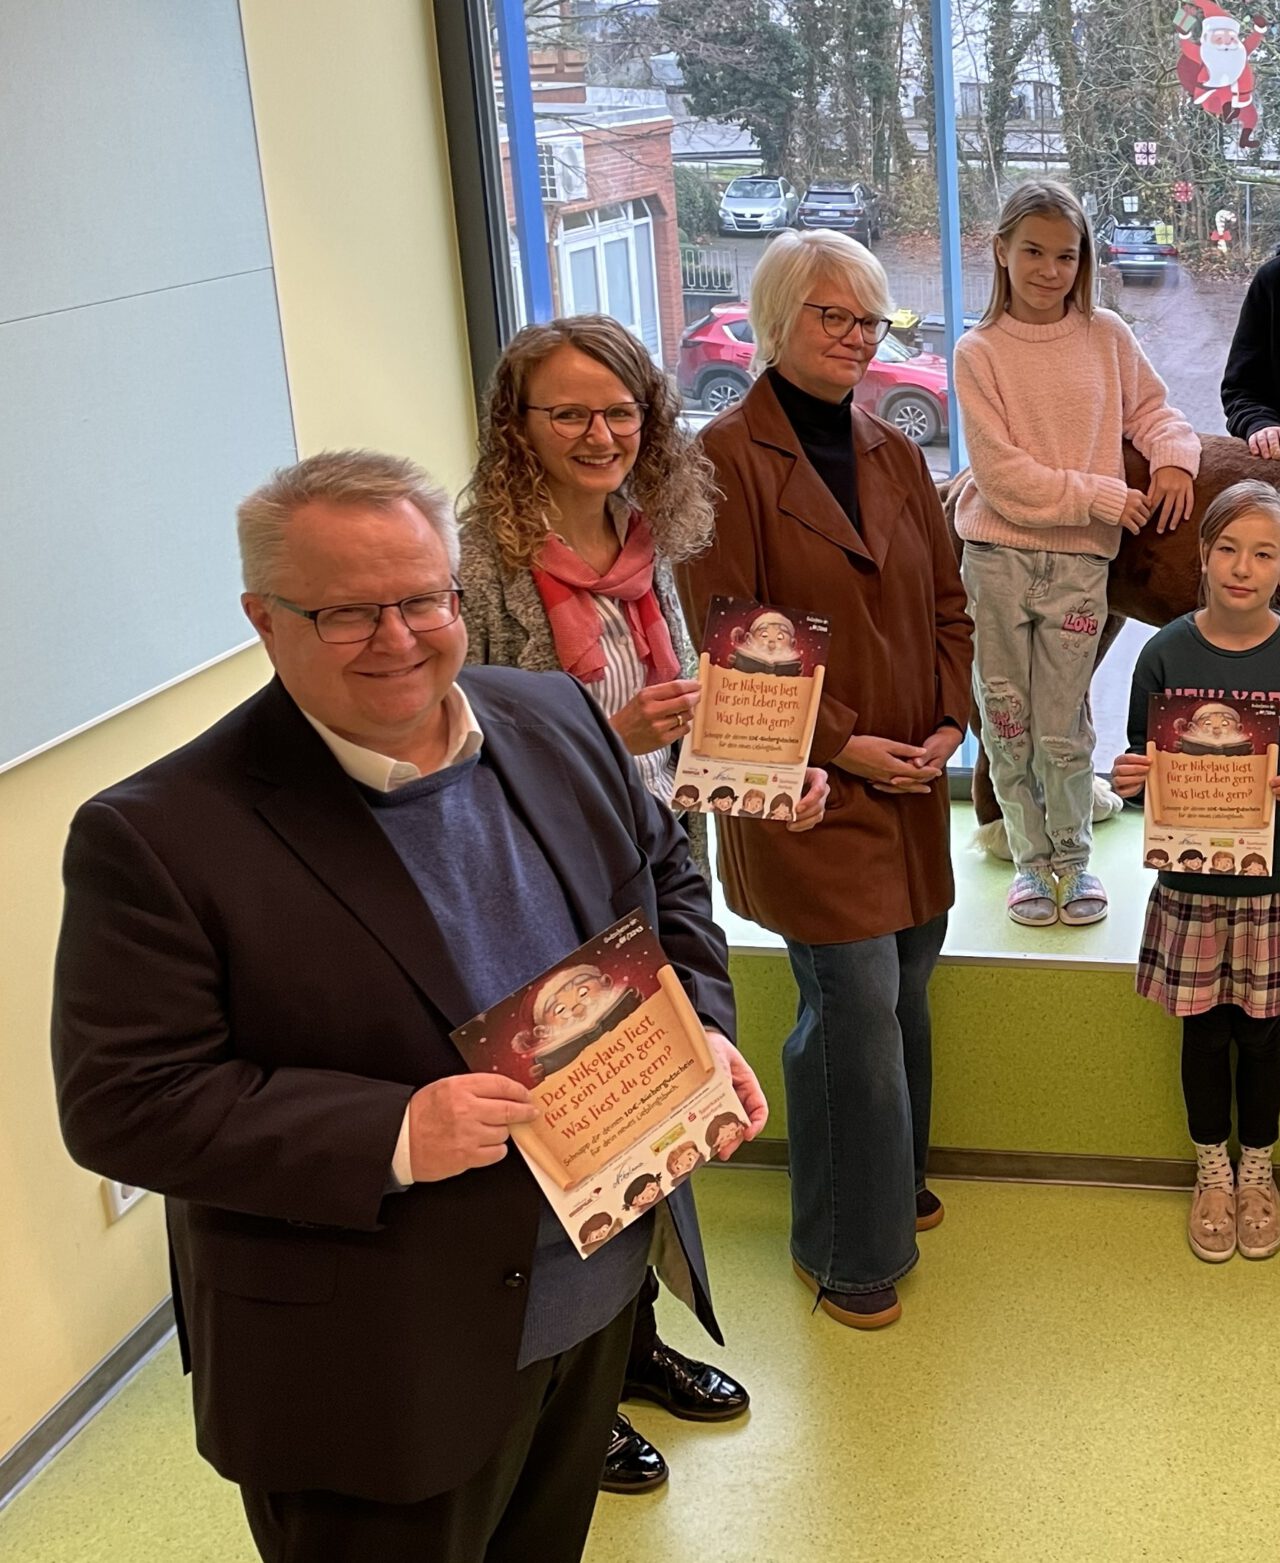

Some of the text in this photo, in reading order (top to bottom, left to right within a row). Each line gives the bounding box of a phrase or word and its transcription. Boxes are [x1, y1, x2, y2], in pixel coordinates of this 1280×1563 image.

[1062, 614, 1098, 636] LOVE
[722, 677, 797, 697] Der Nikolaus liest
[731, 695, 749, 706] sein
[752, 694, 776, 707] Leben
[716, 711, 794, 731] Was liest du gern?
[1171, 759, 1251, 773] Der Nikolaus liest
[1184, 773, 1202, 783] sein
[1205, 772, 1230, 783] Leben
[1170, 787, 1252, 802] Was liest du gern?
[540, 1015, 654, 1106] Der Nikolaus liest
[570, 1083, 596, 1109] sein
[596, 1053, 634, 1084] Leben
[561, 1045, 670, 1138] Was liest du gern?
